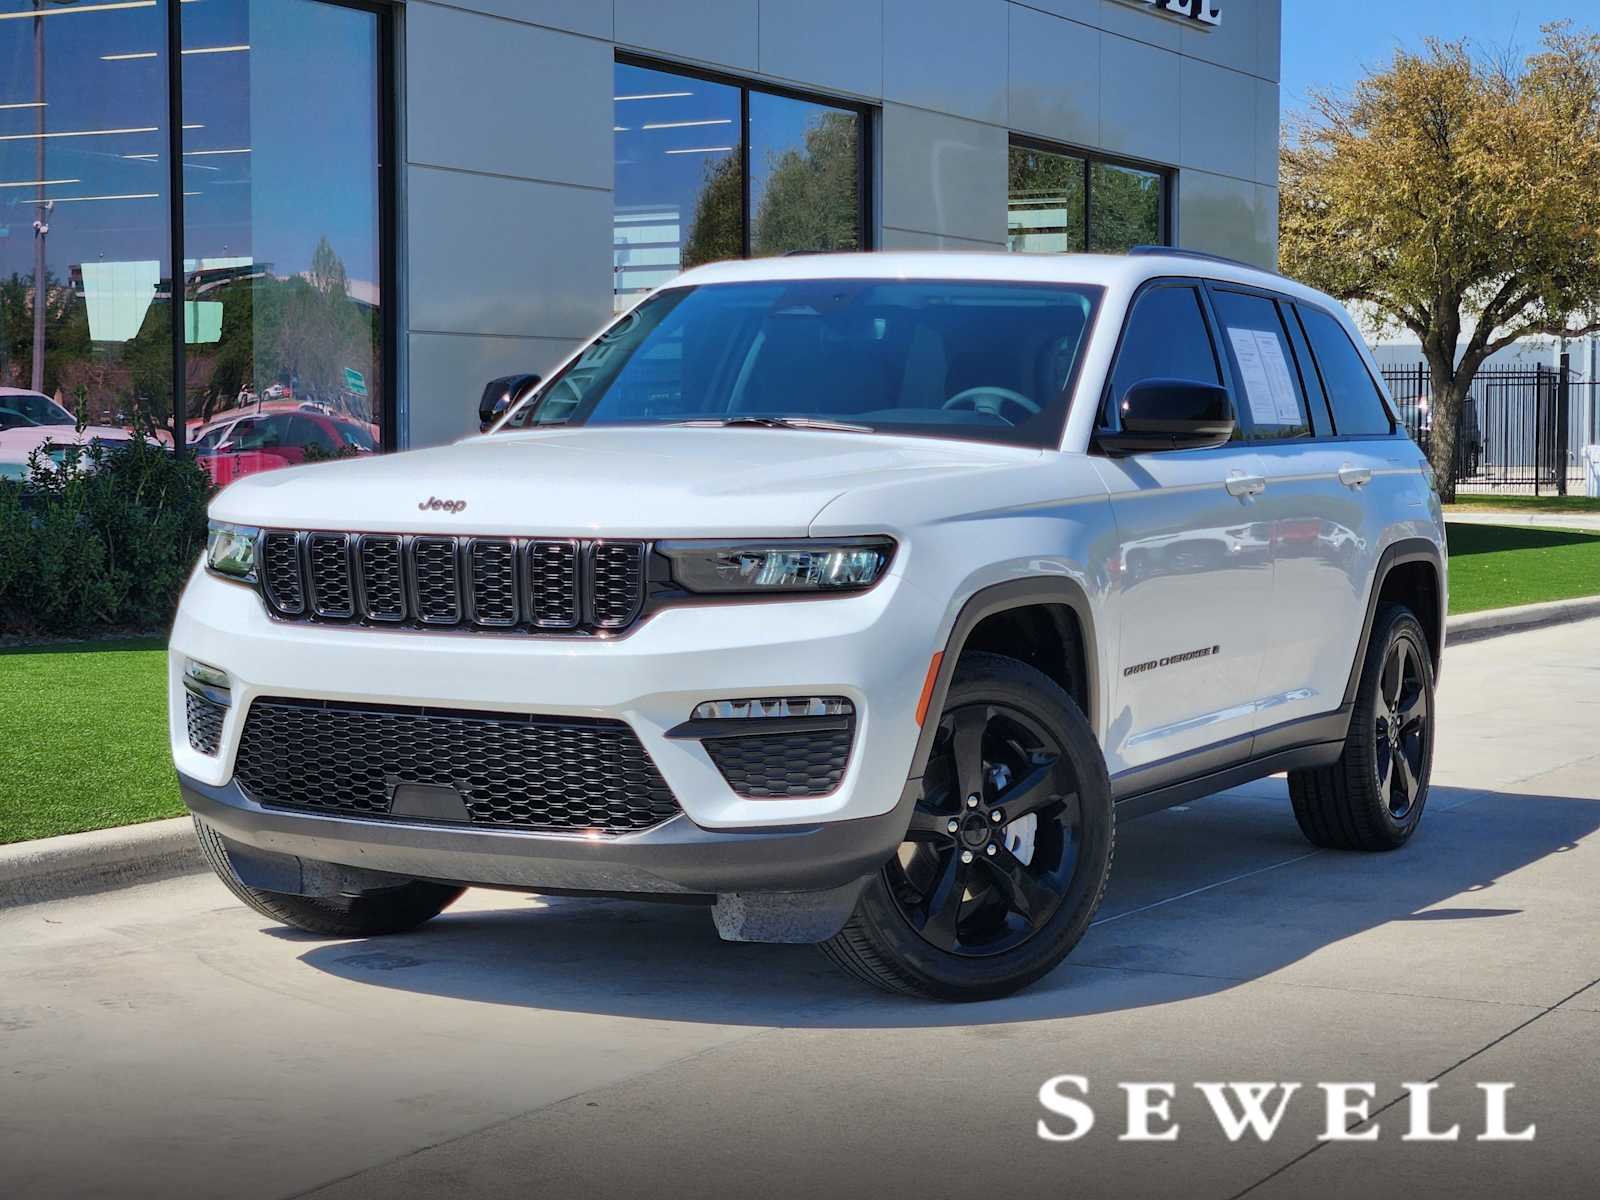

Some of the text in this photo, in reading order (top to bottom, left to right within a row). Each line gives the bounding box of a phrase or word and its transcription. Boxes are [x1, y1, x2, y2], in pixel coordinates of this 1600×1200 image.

[418, 496, 467, 514] Jeep
[1123, 647, 1212, 677] GRAND CHEROKEE
